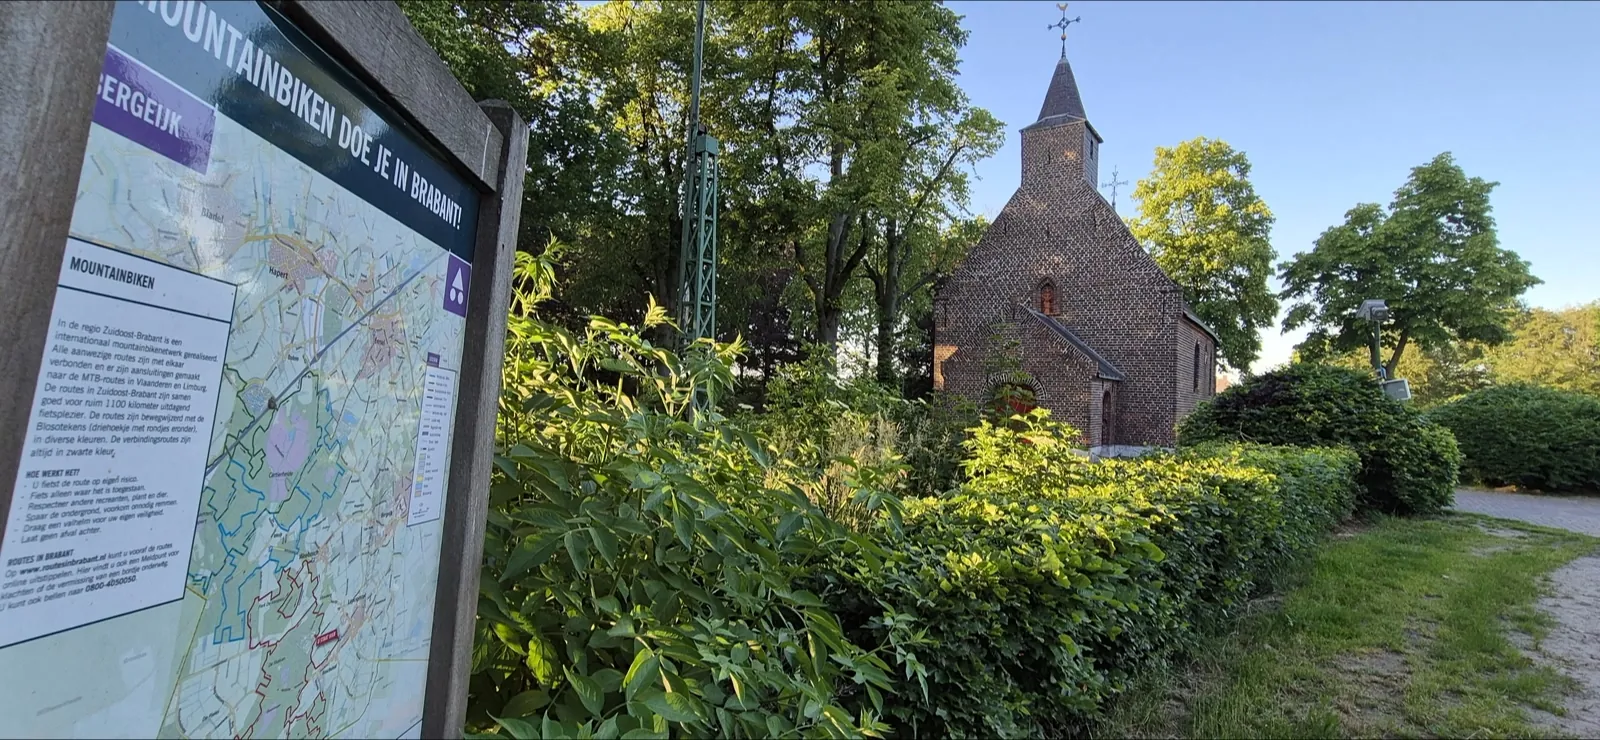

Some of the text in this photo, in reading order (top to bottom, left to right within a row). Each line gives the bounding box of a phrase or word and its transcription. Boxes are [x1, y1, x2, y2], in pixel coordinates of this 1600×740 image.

[139, 0, 463, 230] OUNTAINBIKEN DOE JE IN BRABANT!
[70, 256, 155, 289] MOUNTAINBIKEN
[57, 318, 66, 328] In
[69, 320, 79, 330] de
[82, 324, 101, 334] regio
[103, 326, 162, 343] Zuidoost-Brabant
[55, 330, 218, 362] internationaal mountainbikenetwerk gerealiseerd.
[52, 344, 68, 354] Alle
[71, 348, 112, 360] aanwezige
[138, 356, 150, 365] zijn
[166, 360, 184, 368] elkaar
[49, 358, 92, 370] verbonden
[116, 366, 129, 375] zijn
[131, 368, 174, 379] aansluitingen
[175, 372, 200, 381] gemaakt
[46, 371, 66, 380] naar
[69, 372, 79, 380] de
[82, 373, 125, 385] MTB-routes
[128, 377, 134, 385] in
[136, 378, 172, 389] Vlaanderen
[44, 382, 57, 392] De
[59, 385, 84, 394] routes
[87, 386, 94, 394] in
[97, 386, 158, 399] Zuidoost-Brabant
[158, 392, 170, 400] zijn
[41, 397, 62, 406] goed
[85, 398, 103, 407] ruim
[106, 399, 126, 408] 1100
[128, 400, 159, 410] kilometer
[160, 402, 191, 412] uitdagend
[90, 411, 100, 420] De
[126, 413, 139, 422] zijn
[141, 413, 184, 423] bewegwijzerd
[88, 423, 130, 434] (driehoekje
[147, 425, 170, 434] rondjes
[33, 436, 42, 444] in
[44, 435, 75, 444] diverse
[77, 436, 108, 444] kleuren.
[110, 435, 121, 444] De
[123, 436, 179, 444] verbindingsroutes
[30, 448, 53, 458] altijd
[56, 448, 64, 456] in
[66, 448, 93, 456] zwarte
[26, 470, 40, 478] HOE
[42, 470, 64, 478] WERKT
[102, 477, 120, 486] eigen
[7, 556, 34, 567] ROUTES
[45, 549, 74, 560] BRABANT
